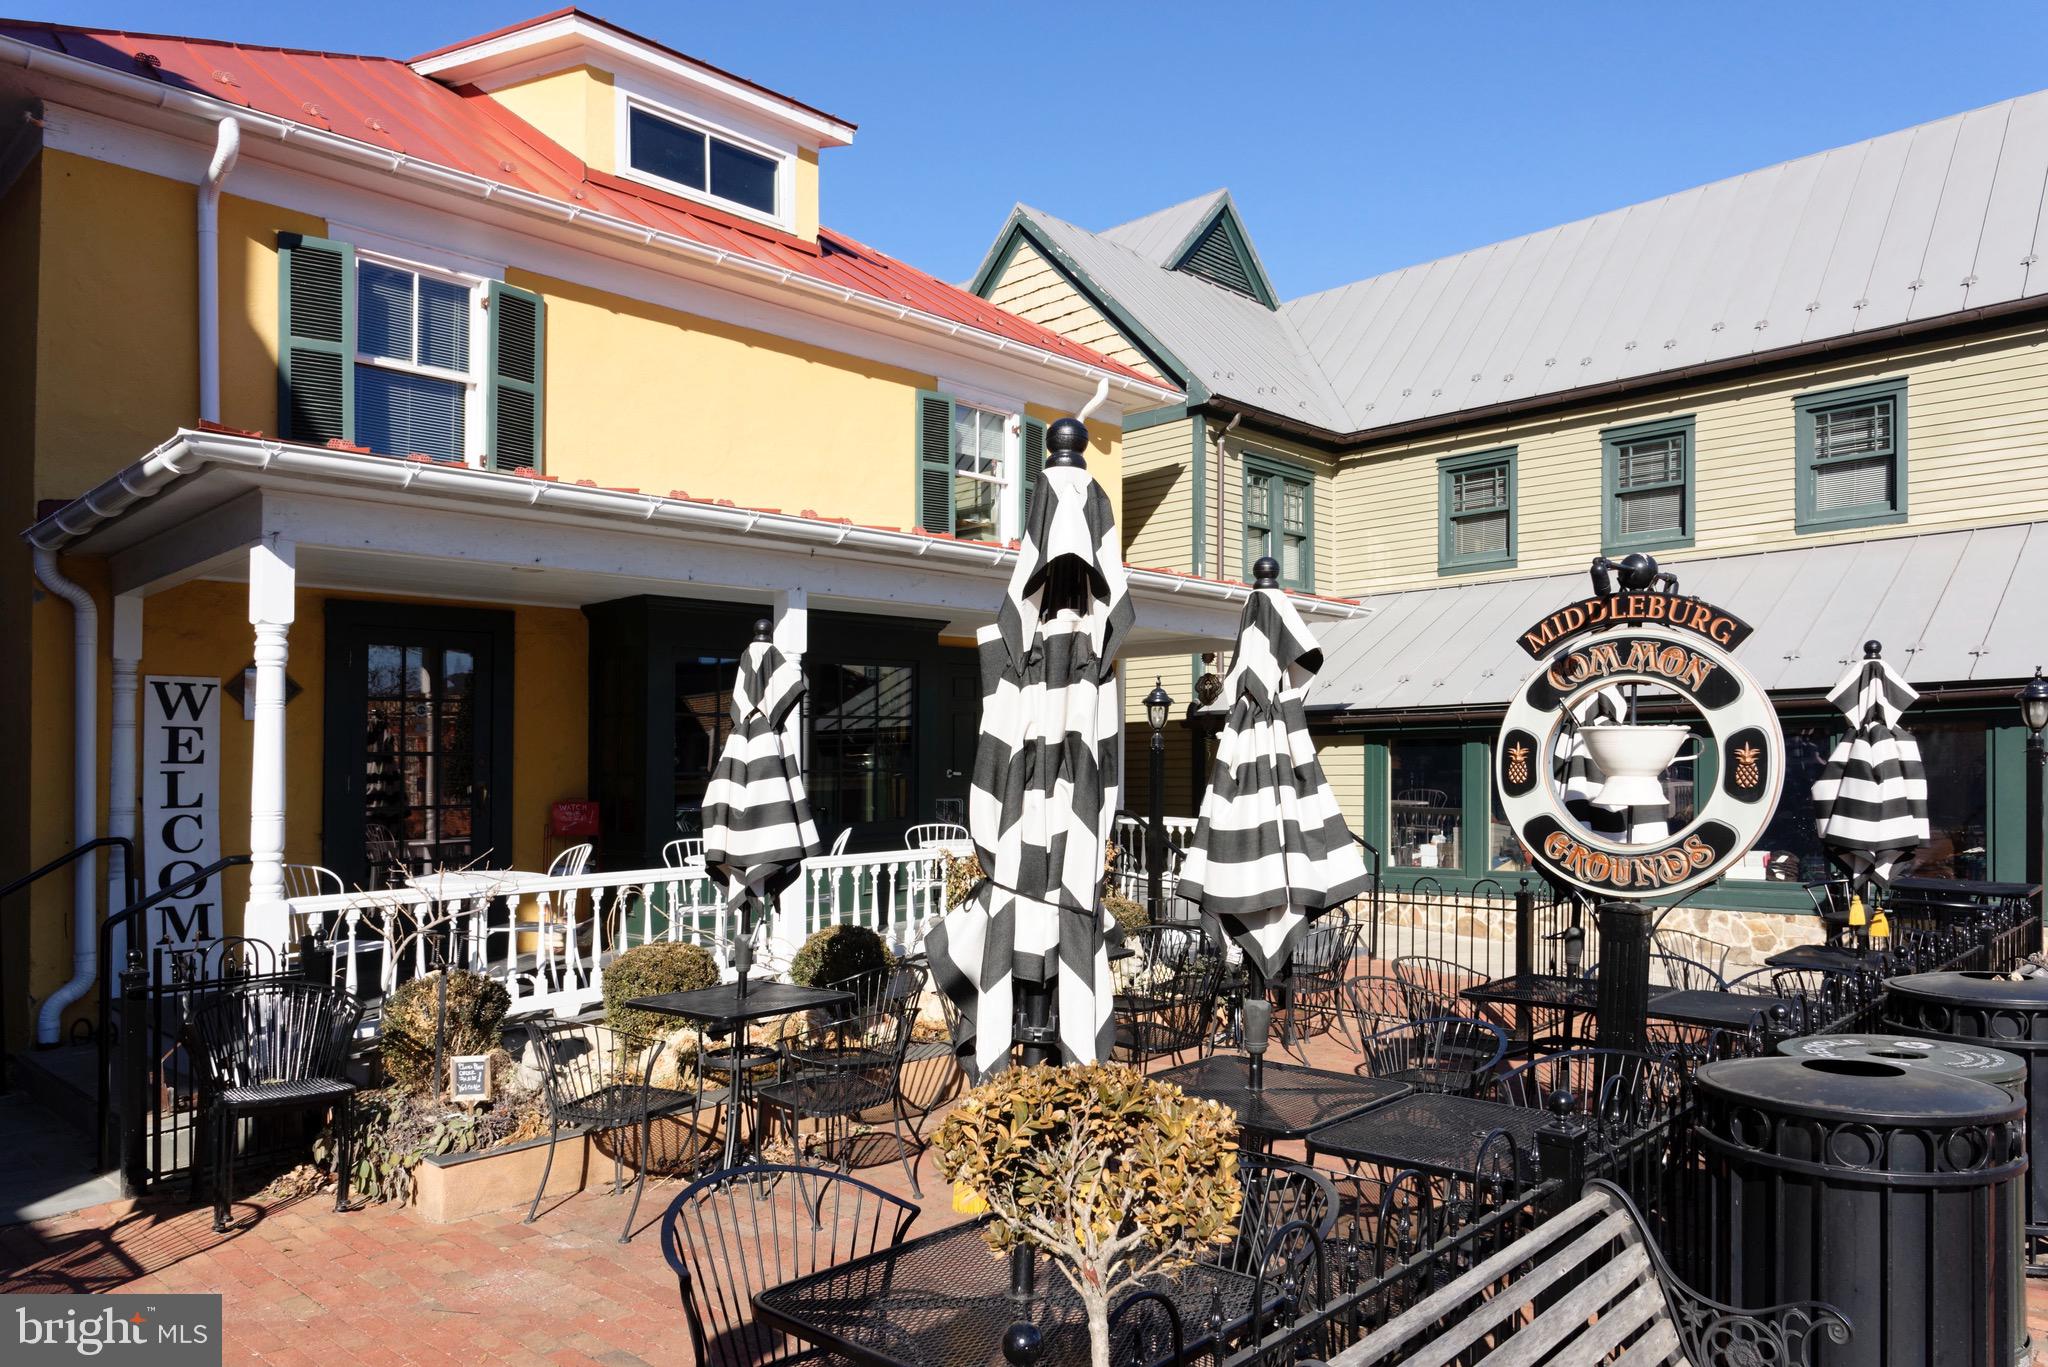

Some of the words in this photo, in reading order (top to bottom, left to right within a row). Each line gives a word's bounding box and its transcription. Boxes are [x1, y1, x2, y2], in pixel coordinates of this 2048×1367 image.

[1524, 594, 1738, 654] MIDDLEBURG
[1546, 640, 1718, 692] COMMON
[1543, 831, 1716, 887] GROUNDS
